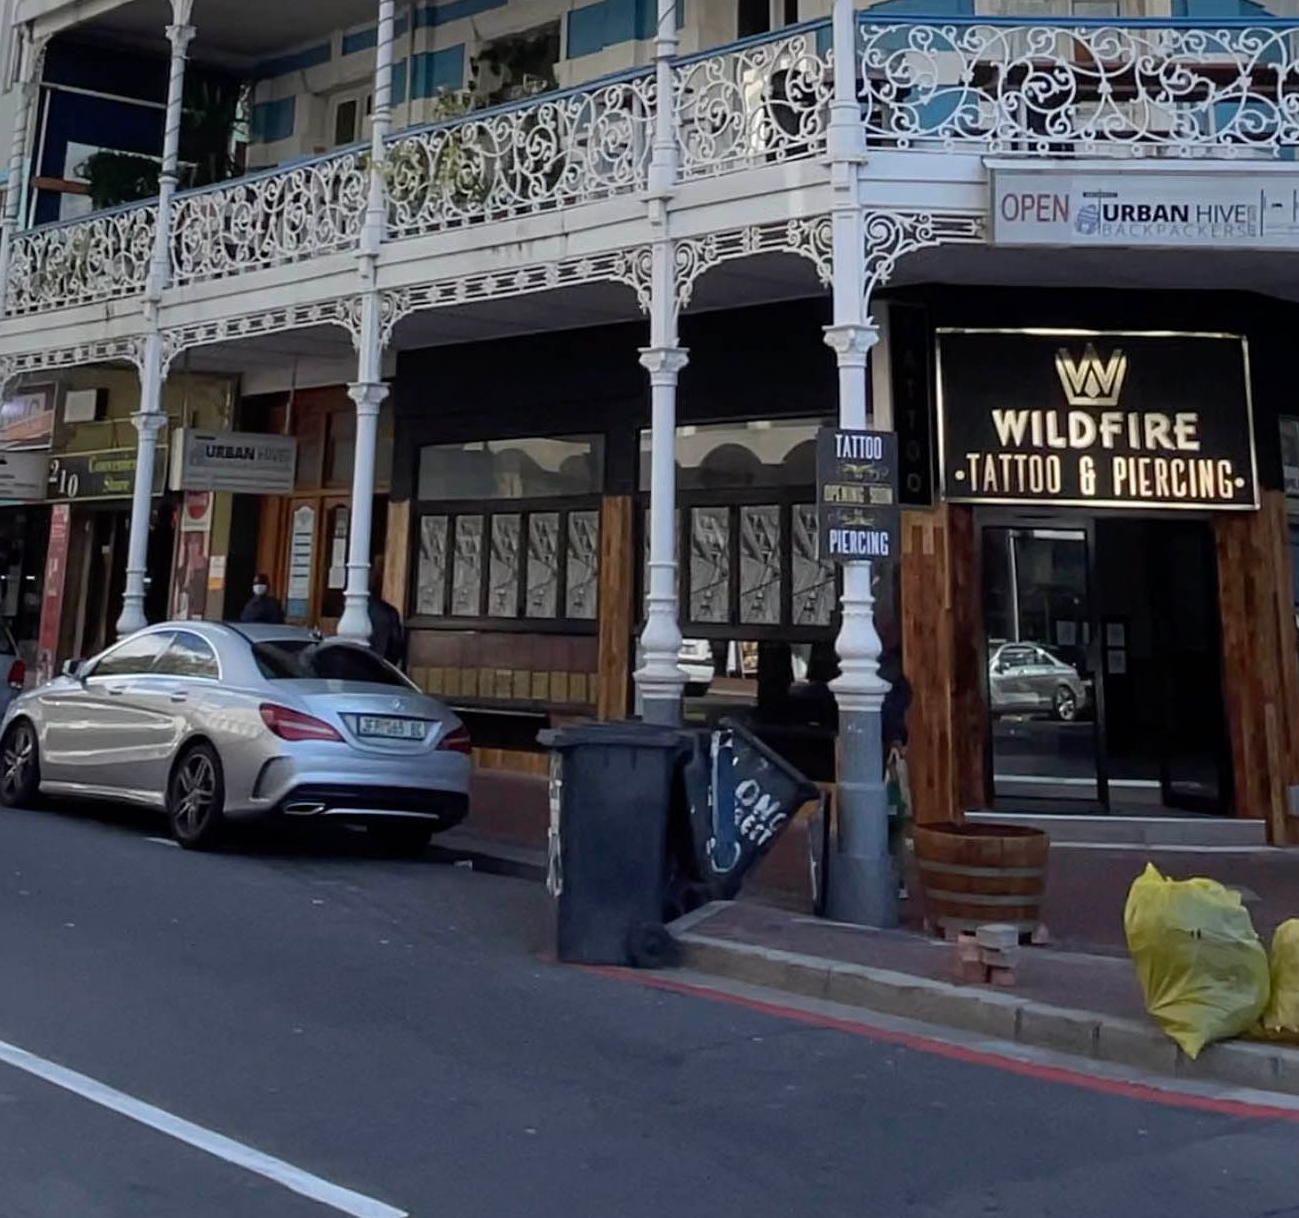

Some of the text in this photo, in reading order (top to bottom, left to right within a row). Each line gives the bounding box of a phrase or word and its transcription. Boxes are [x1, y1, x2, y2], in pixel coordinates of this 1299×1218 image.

[1000, 193, 1069, 223] OPEN
[1103, 204, 1188, 223] URBAN
[1196, 204, 1247, 224] HIVE
[1103, 223, 1247, 239] BACKPACKERS
[991, 409, 1200, 451] WILDFIRE
[205, 445, 255, 460] URBAN
[835, 434, 883, 460] TATTOO
[49, 459, 79, 499] 210
[966, 453, 1234, 499] TATTOO & PIERCING
[829, 529, 889, 556] PIERCING
